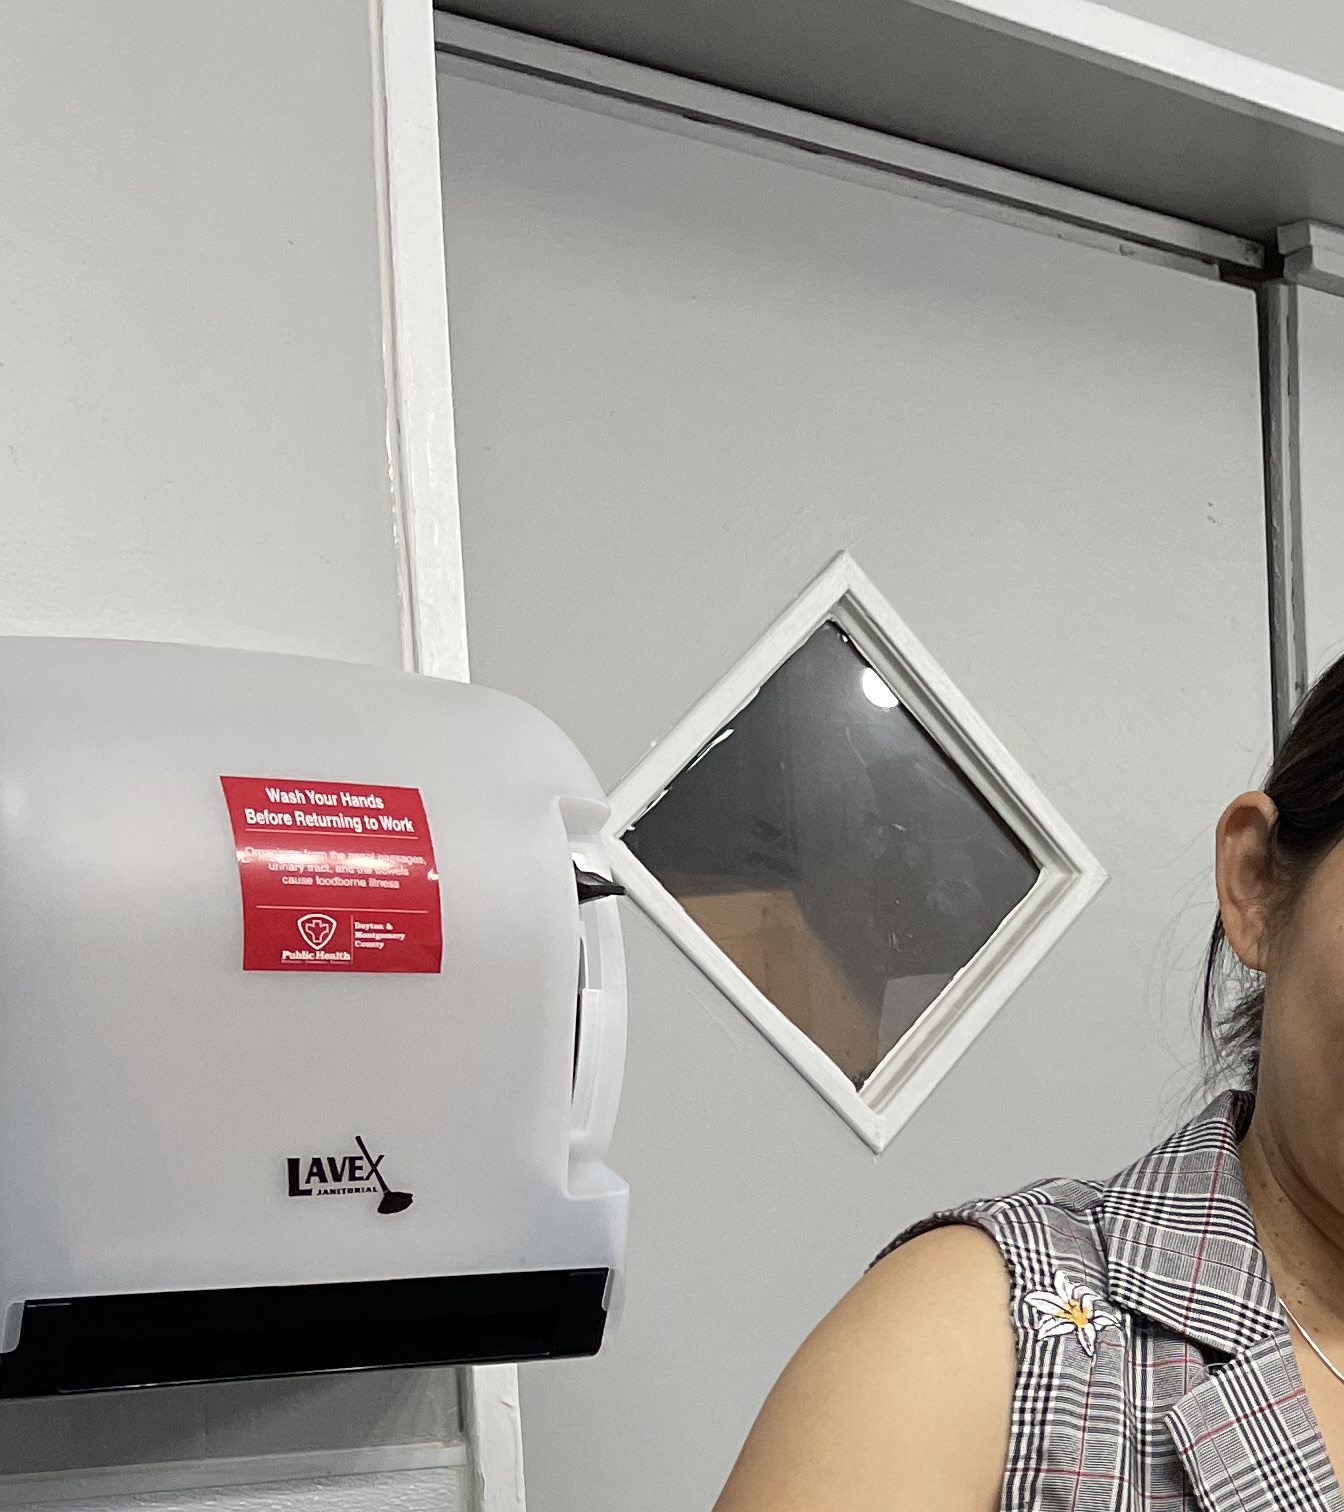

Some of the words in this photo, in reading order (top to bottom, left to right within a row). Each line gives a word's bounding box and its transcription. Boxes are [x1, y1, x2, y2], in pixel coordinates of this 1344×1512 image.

[265, 787, 304, 804] Wash
[306, 789, 338, 806] Your
[340, 791, 384, 809] Hands
[244, 808, 293, 826] Before
[294, 811, 362, 832] Returning
[364, 815, 379, 829] to
[379, 816, 415, 832] Work
[282, 875, 313, 886] cause
[316, 876, 367, 888] foodborne
[354, 931, 406, 941] Montgomery
[354, 941, 385, 949] County
[282, 950, 315, 960] Public
[315, 951, 351, 961] Health
[287, 1136, 389, 1197] LAVEX
[316, 1186, 378, 1196] JANITORIAL
